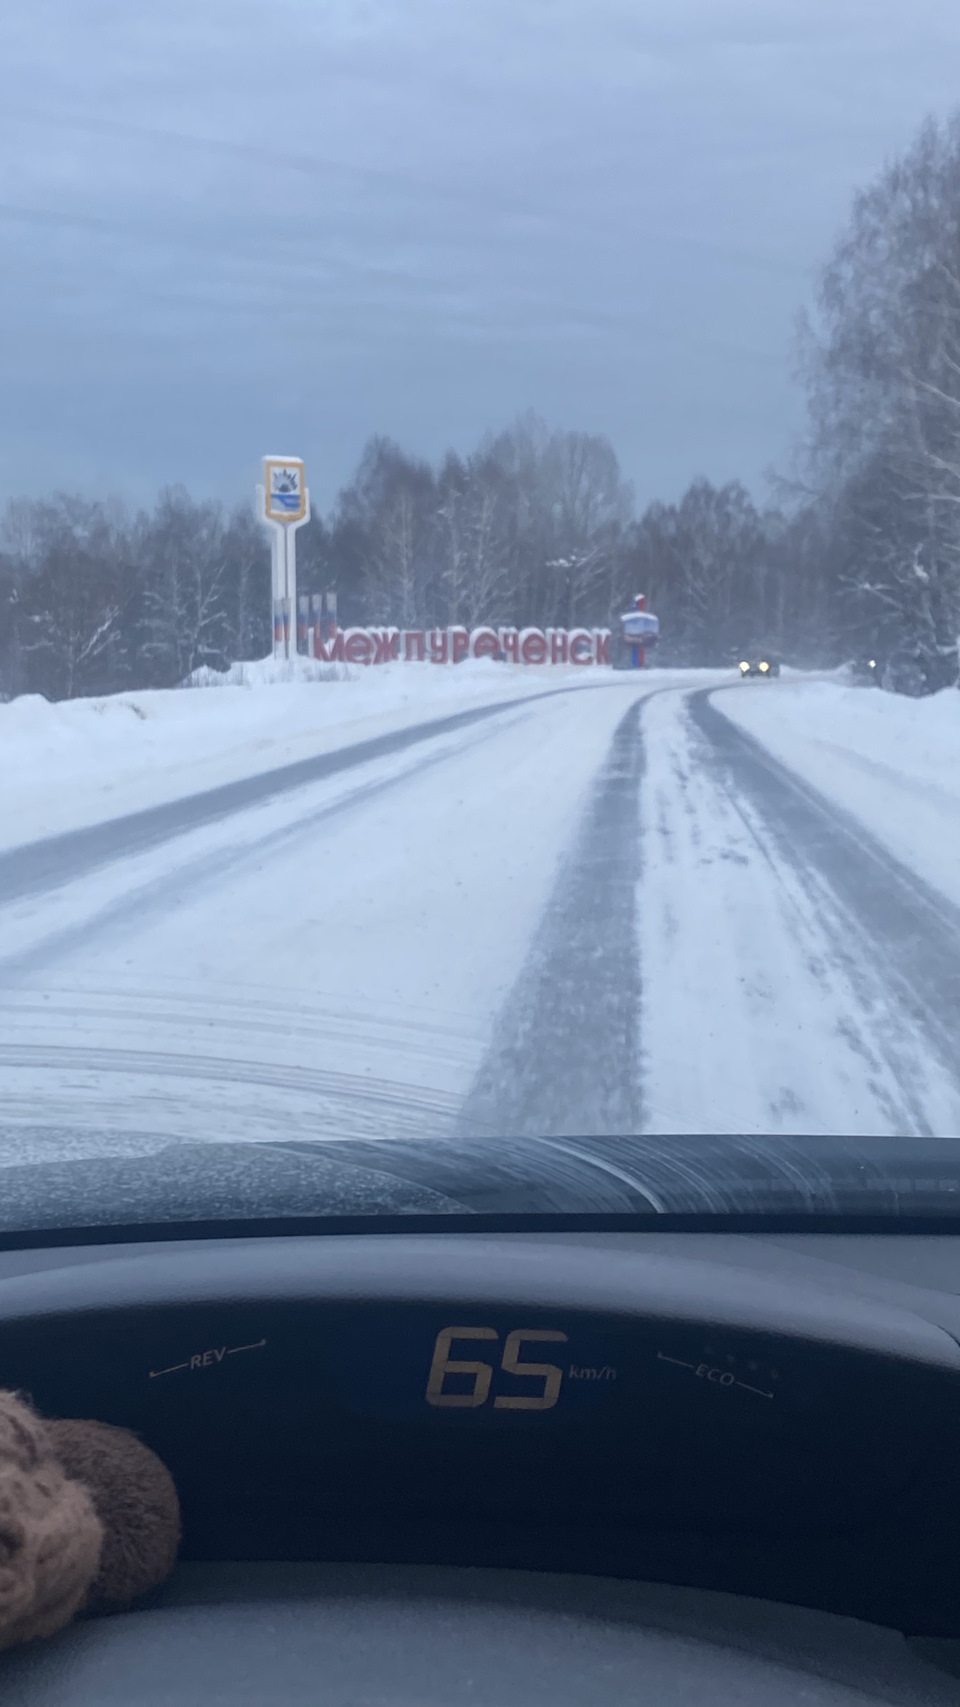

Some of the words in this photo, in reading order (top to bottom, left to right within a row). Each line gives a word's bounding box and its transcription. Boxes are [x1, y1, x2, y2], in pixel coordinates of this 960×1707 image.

[190, 1345, 227, 1370] REV
[425, 1325, 569, 1410] 65
[568, 1364, 617, 1380] km/h
[695, 1363, 735, 1386] ECO
